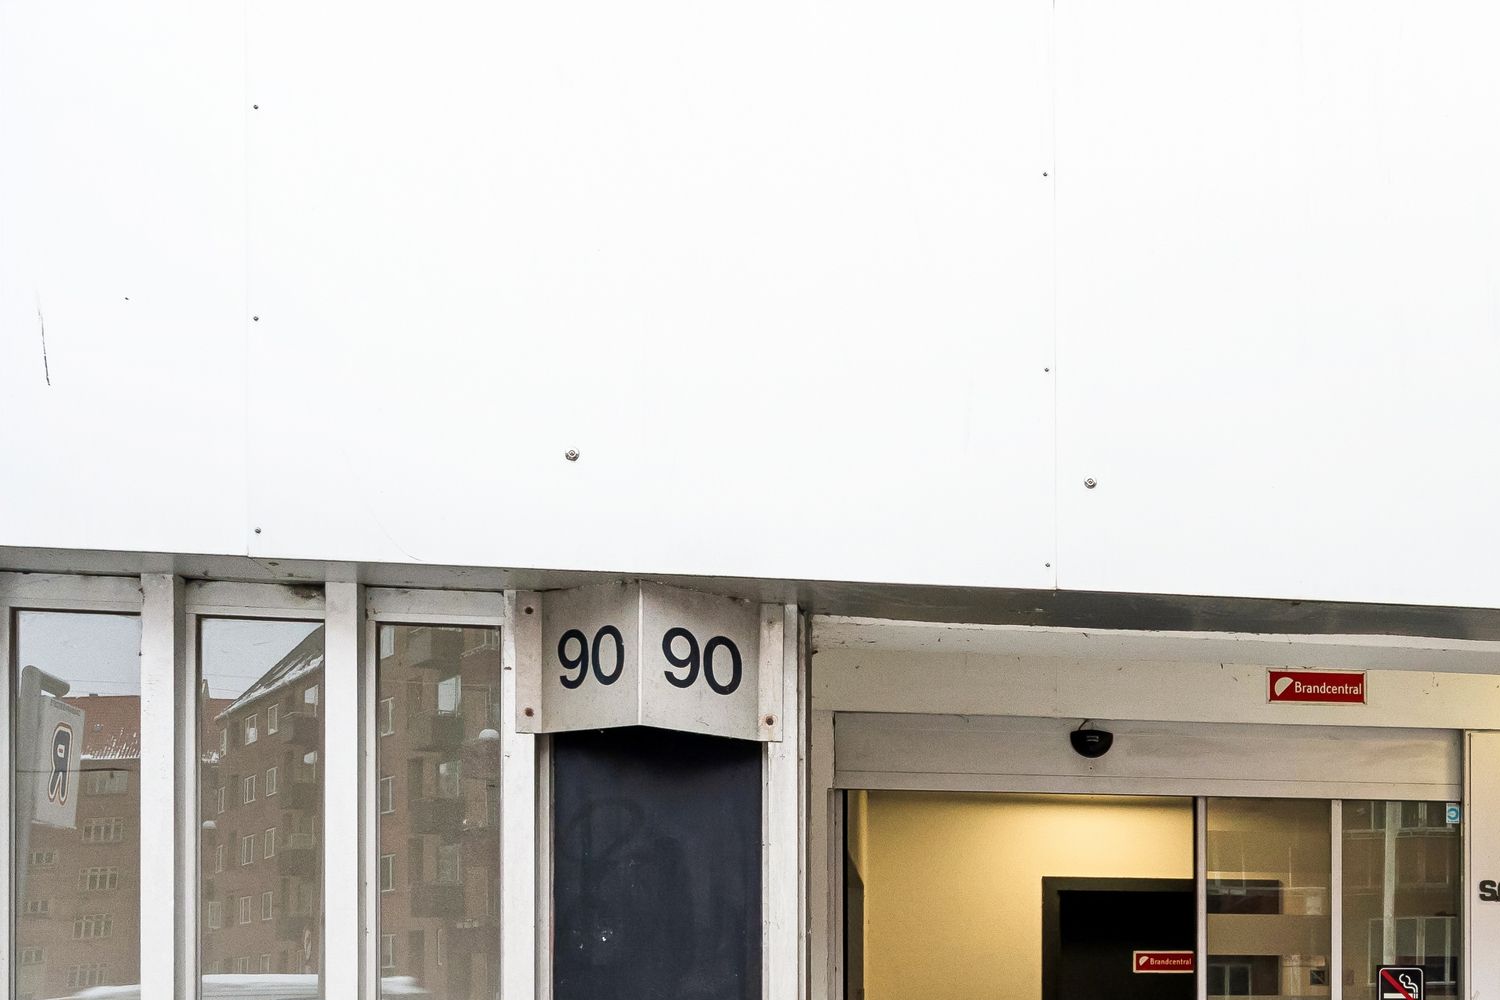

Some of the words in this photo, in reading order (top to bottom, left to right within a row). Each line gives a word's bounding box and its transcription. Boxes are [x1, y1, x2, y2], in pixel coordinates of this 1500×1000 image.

[557, 624, 626, 690] 90
[661, 626, 743, 696] 90
[1294, 681, 1363, 697] Brandcentral
[1149, 956, 1193, 967] Brandcentral
